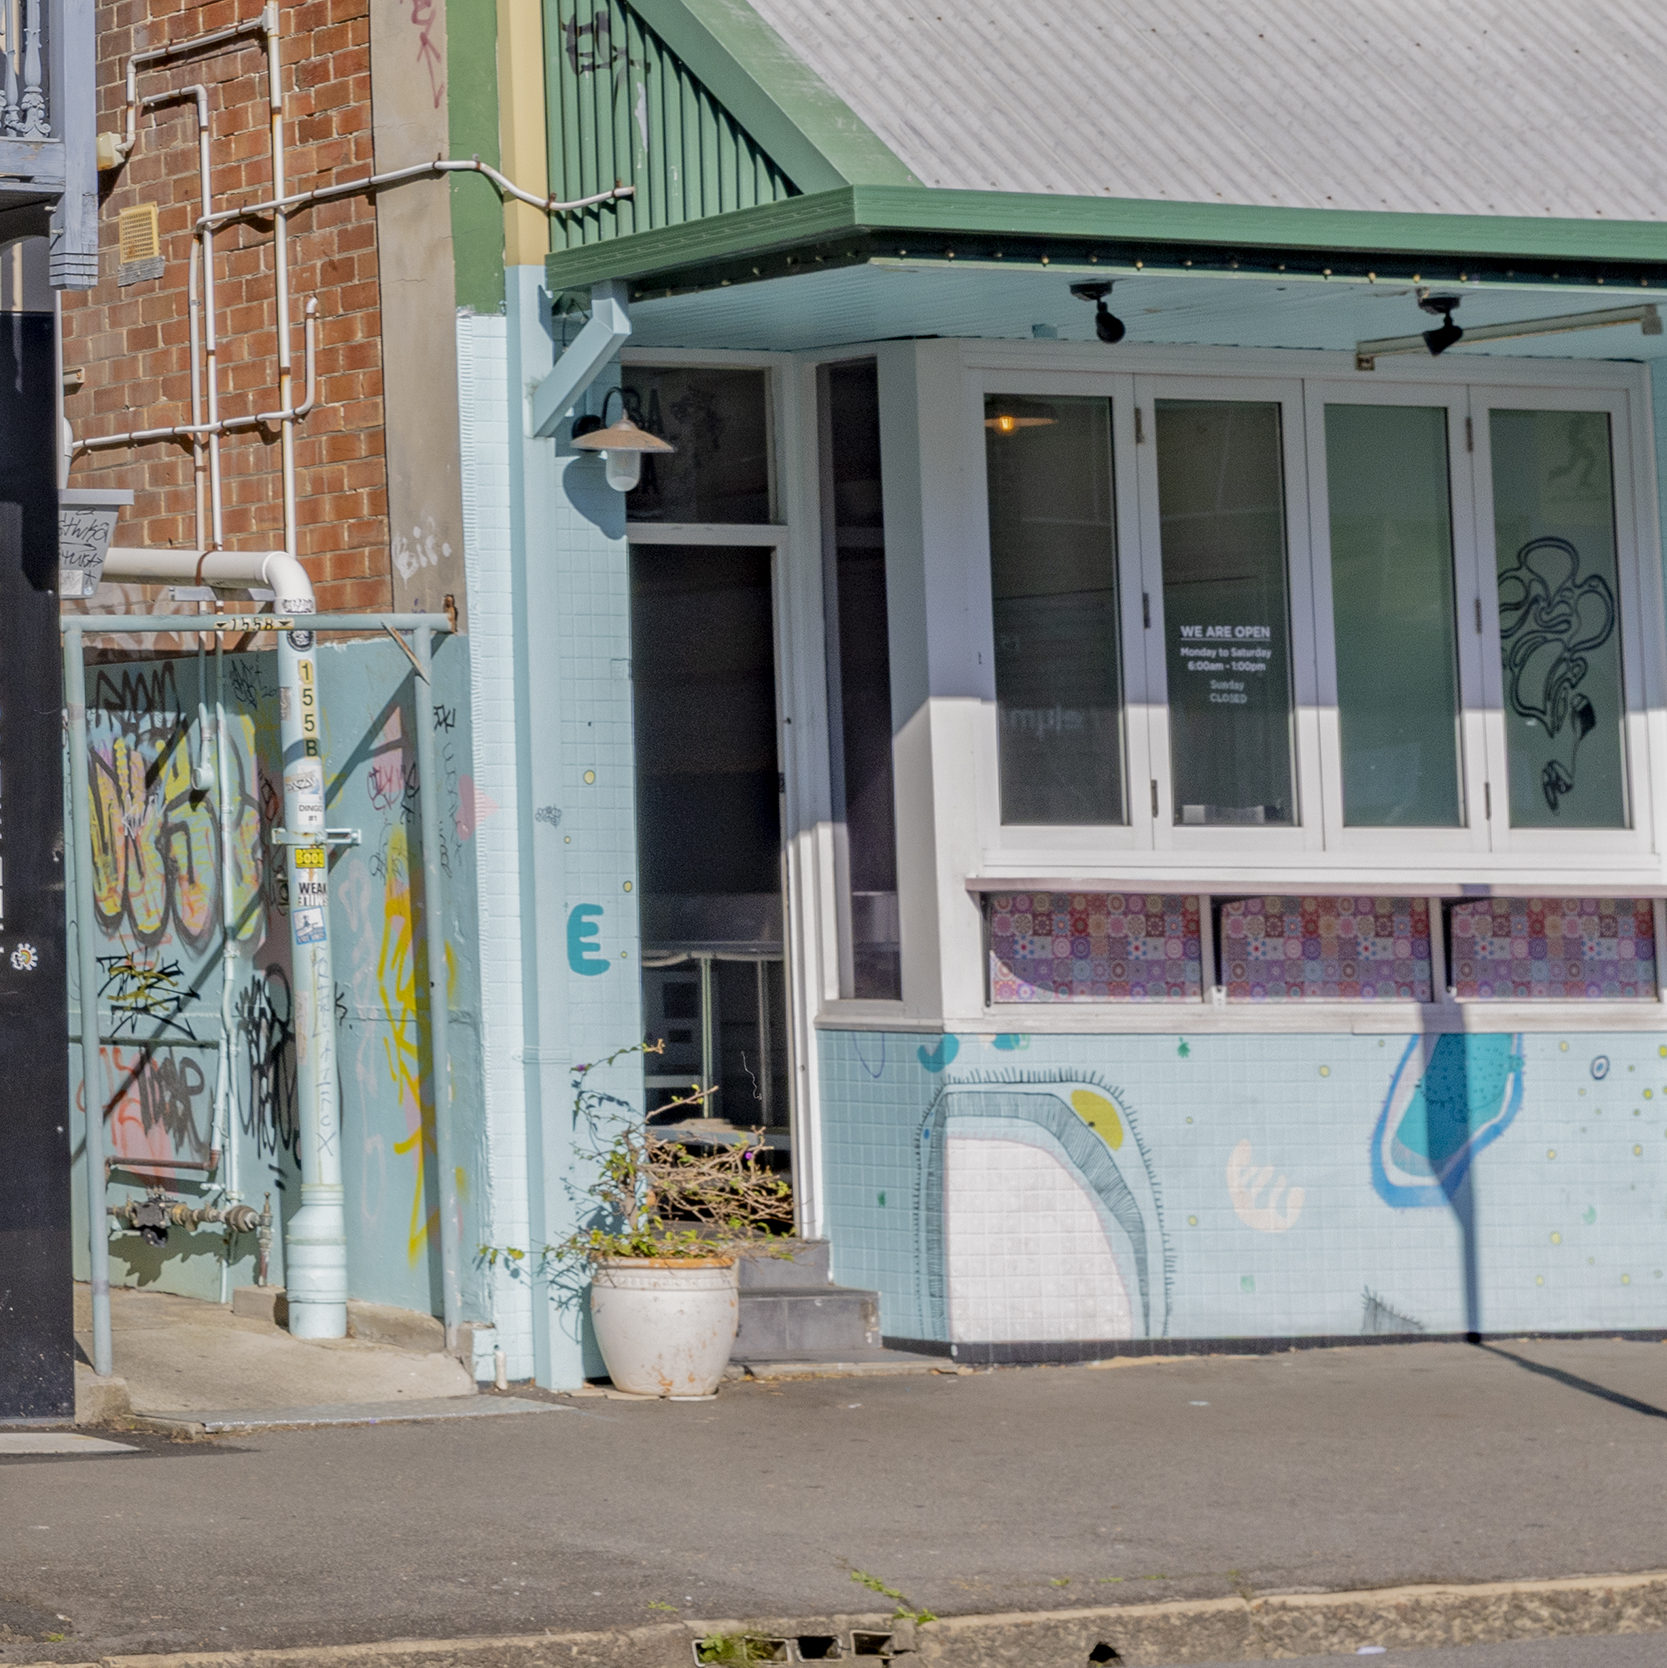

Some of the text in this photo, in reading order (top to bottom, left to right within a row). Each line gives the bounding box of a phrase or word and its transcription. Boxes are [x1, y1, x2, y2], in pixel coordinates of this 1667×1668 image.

[1180, 625, 1271, 638] WE ARE OPEN
[1180, 647, 1272, 660] Monday to Saturday
[1210, 679, 1245, 692] Sunday
[1209, 692, 1247, 704] CLOSED
